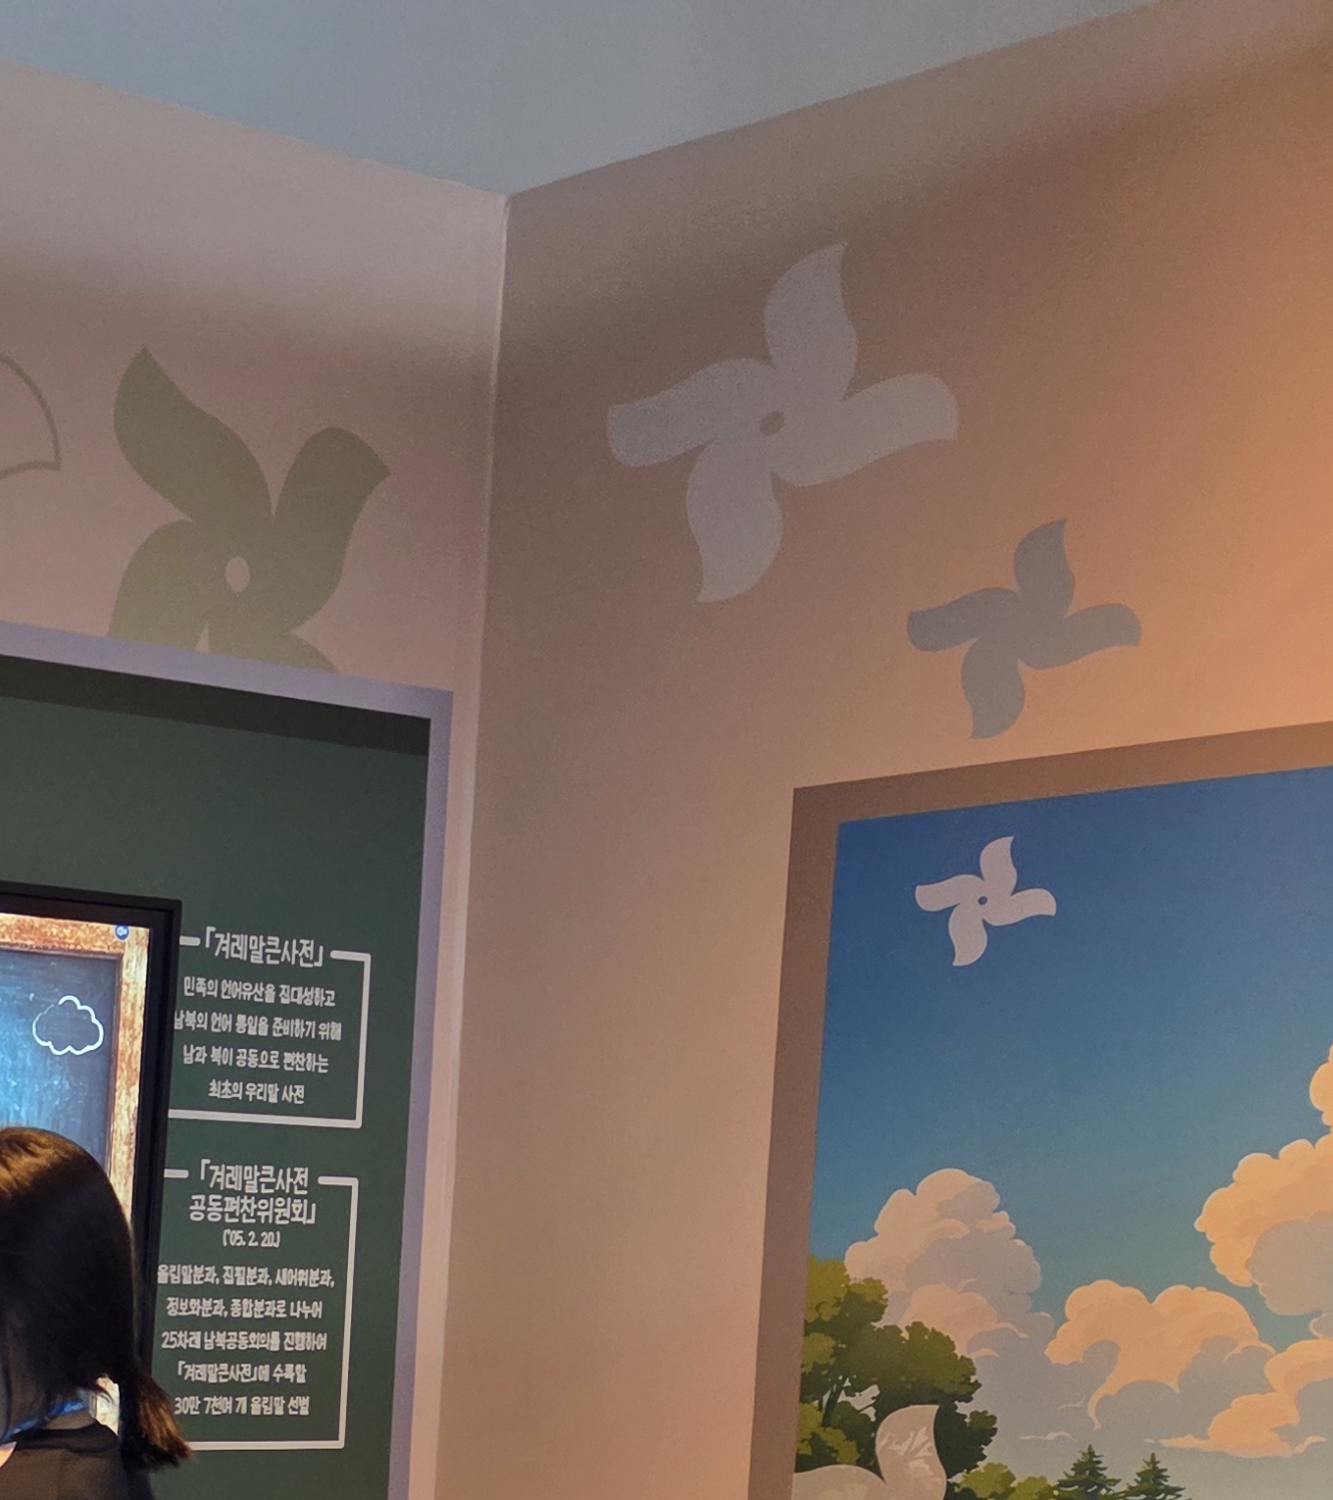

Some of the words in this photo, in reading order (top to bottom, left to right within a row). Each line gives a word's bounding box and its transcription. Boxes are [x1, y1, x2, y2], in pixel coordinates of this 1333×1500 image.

[184, 976, 218, 997] 민족의
[221, 979, 276, 1004] 언어유산을
[279, 984, 336, 1008] 집대성하고
[173, 1010, 208, 1031] 남북의
[210, 1012, 233, 1033] 언어
[235, 1014, 269, 1037] 통일을
[272, 1017, 315, 1039] 준비하기
[318, 1021, 342, 1041] 위해
[183, 1044, 207, 1064] 남과
[210, 1045, 233, 1067] 북이
[236, 1049, 280, 1070] 공동으로
[283, 1051, 329, 1074] 편찬하는
[208, 1079, 243, 1100] 최초의
[245, 1081, 279, 1104] 우리말
[282, 1083, 305, 1105] 사전
[157, 1264, 220, 1285] 올림말분과,
[222, 1265, 272, 1287] 집필분과,
[275, 1268, 335, 1288] 새어휘분과,
[166, 1296, 229, 1318] 정보화분과,
[230, 1298, 287, 1319] 종합분과로
[290, 1301, 323, 1319] 나누어
[161, 1330, 201, 1350] 25차례
[203, 1331, 280, 1351] 남북공동회의를
[283, 1332, 328, 1351] 진행하여
[273, 1364, 307, 1384] 수록할
[174, 1397, 201, 1415] 30만
[204, 1397, 233, 1415] 7천여
[235, 1397, 248, 1414] 개
[250, 1397, 286, 1416] 올림말
[288, 1397, 310, 1416] 선별
